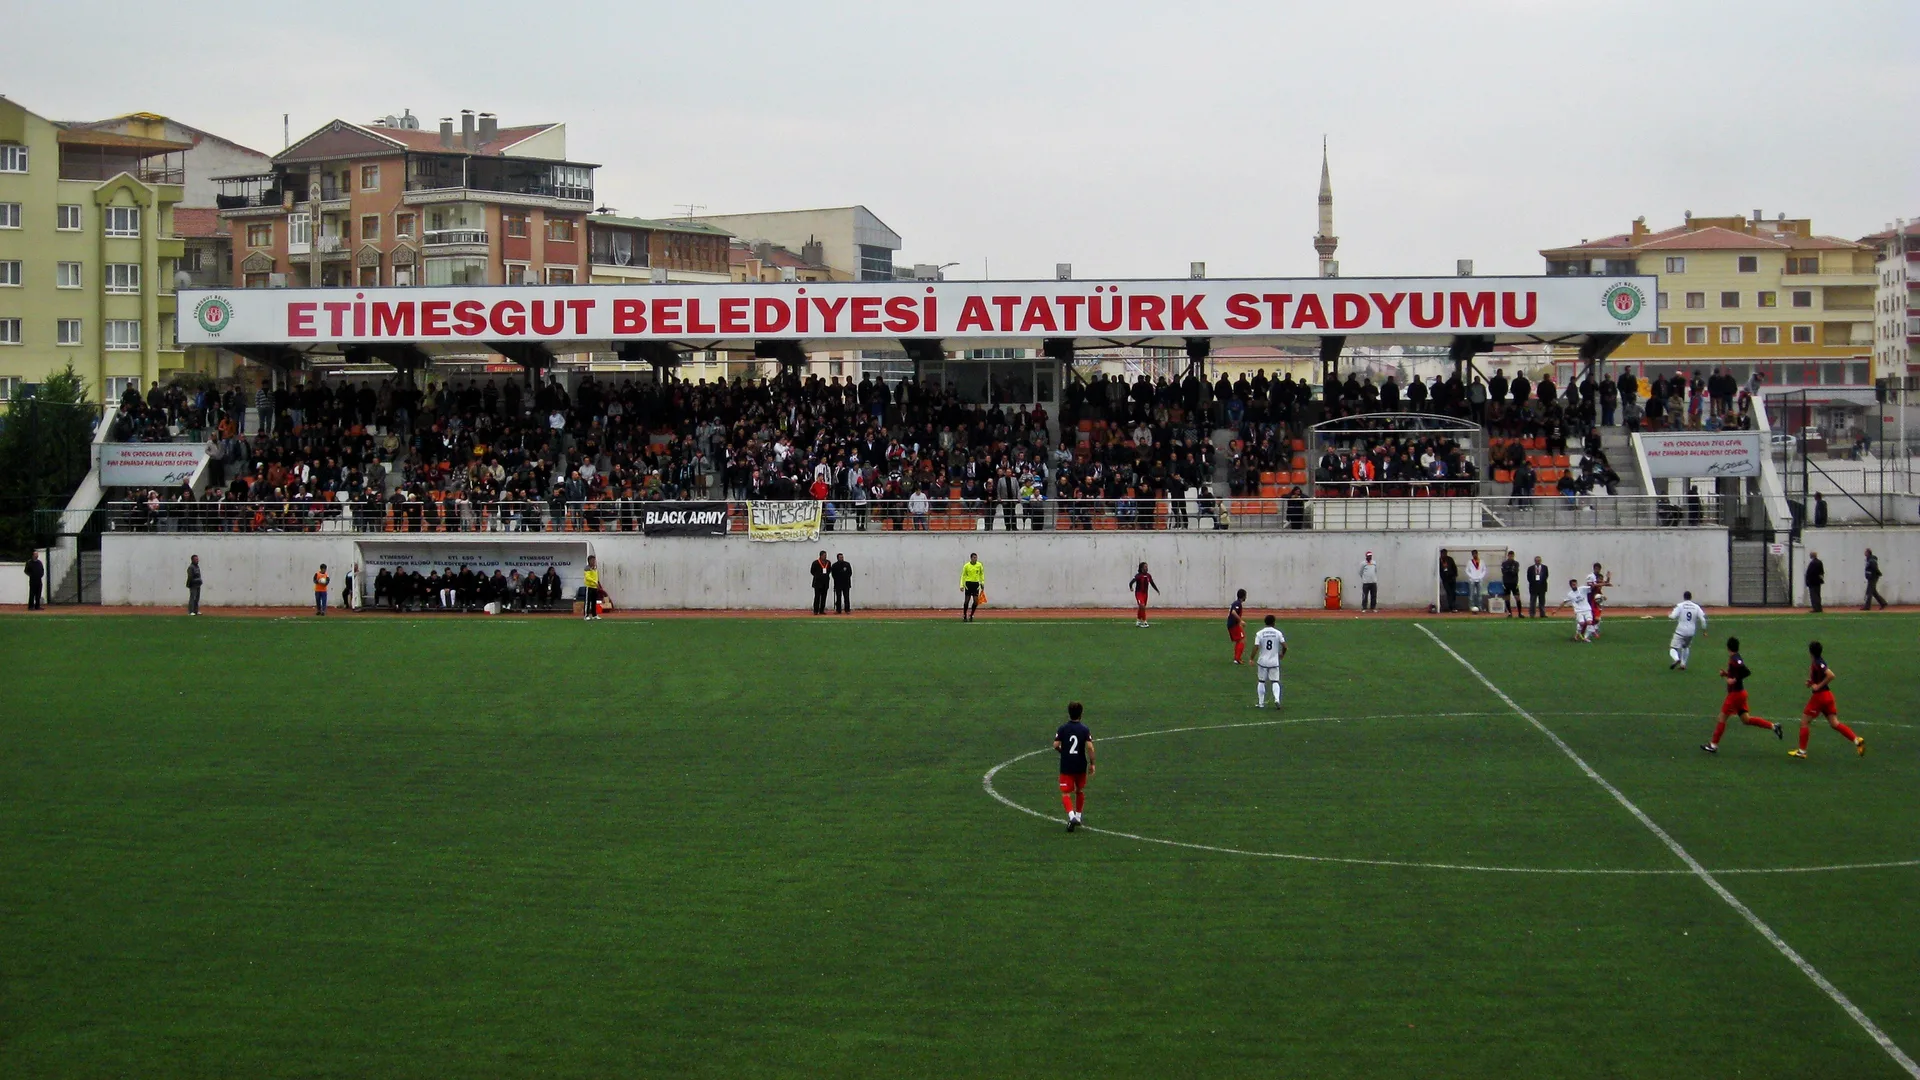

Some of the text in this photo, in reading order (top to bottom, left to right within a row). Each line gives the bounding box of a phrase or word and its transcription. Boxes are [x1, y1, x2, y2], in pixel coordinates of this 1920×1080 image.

[288, 285, 1537, 337] ETİMESGUT BELEDİYESİ ATATÜRK STADYUMU
[646, 511, 726, 524] BLACK ARMY
[1686, 611, 1692, 621] 9
[1266, 639, 1273, 651] 8
[1069, 734, 1079, 755] 2
